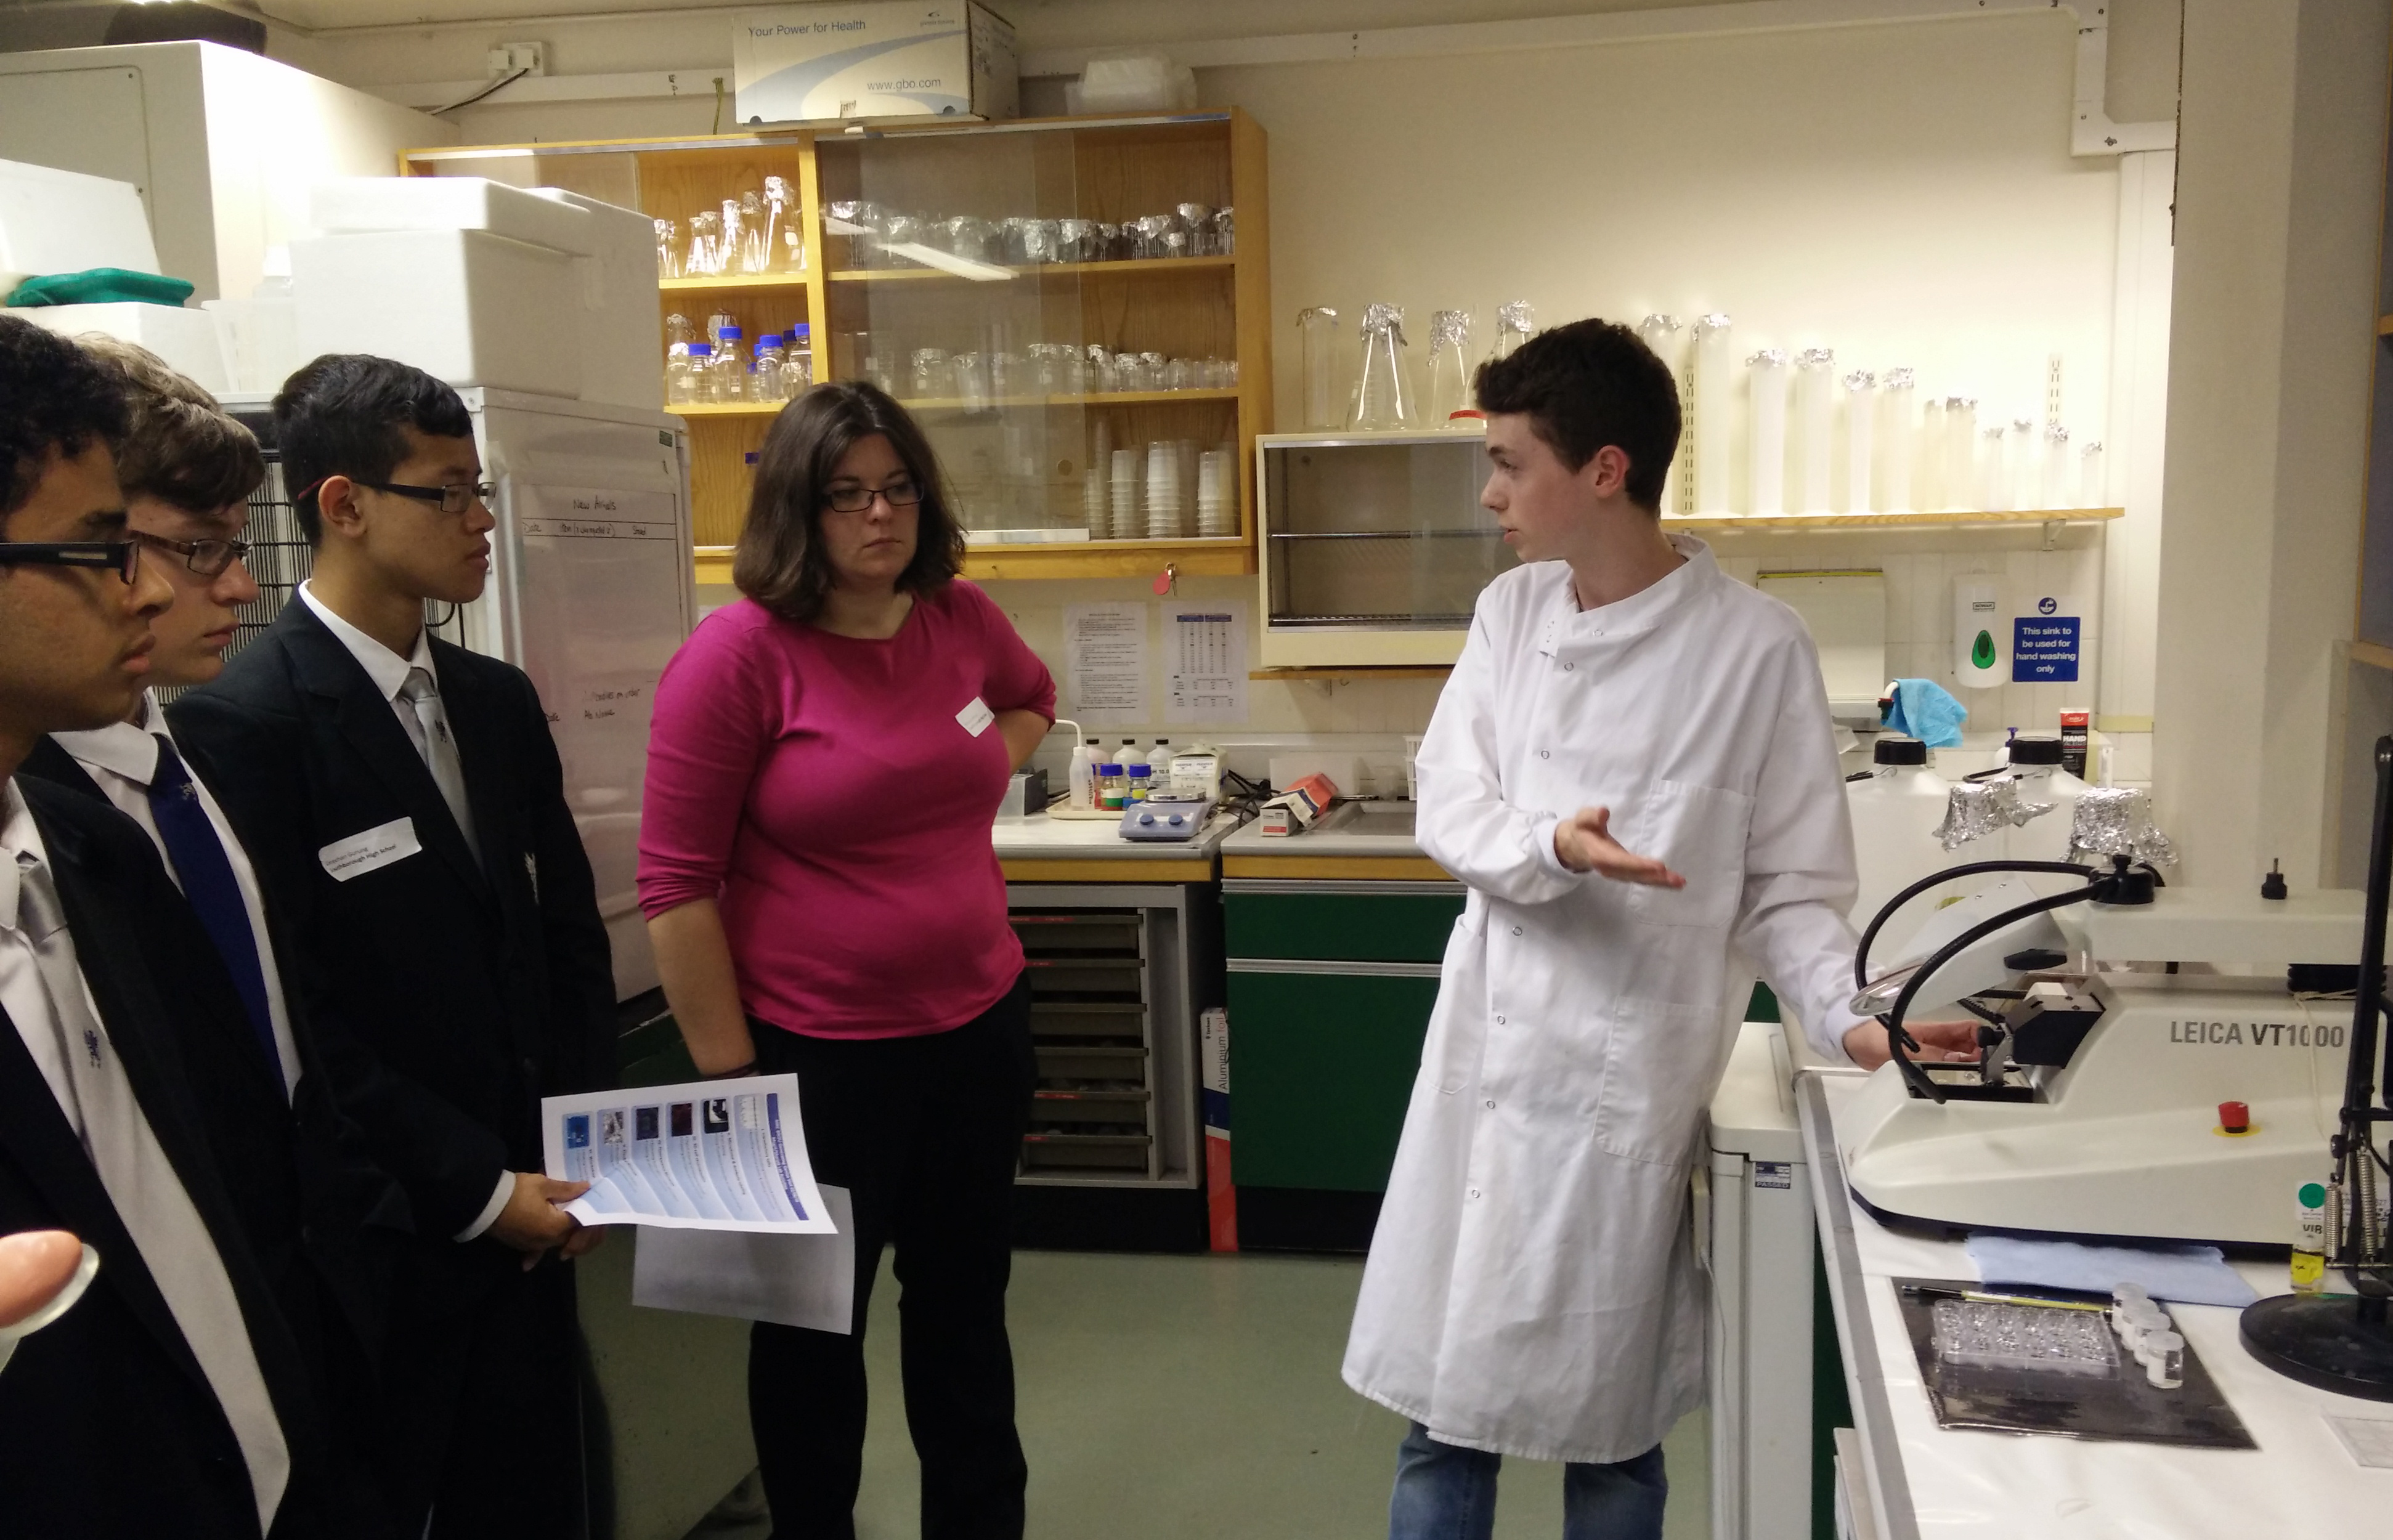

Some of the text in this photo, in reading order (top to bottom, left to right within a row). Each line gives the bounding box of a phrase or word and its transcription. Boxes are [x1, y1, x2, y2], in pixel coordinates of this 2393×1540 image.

[748, 20, 866, 37] Your Power for Health
[867, 78, 941, 92] www.gbo.com
[573, 498, 590, 510] New
[522, 522, 542, 534] Date
[2022, 627, 2072, 635] This sink to
[2058, 639, 2071, 647] for
[2016, 652, 2076, 662] hand washing
[2036, 665, 2055, 674] only
[2171, 1021, 2345, 1048] LEICA VT1000
[1216, 1017, 1227, 1089] Aluminium foil
